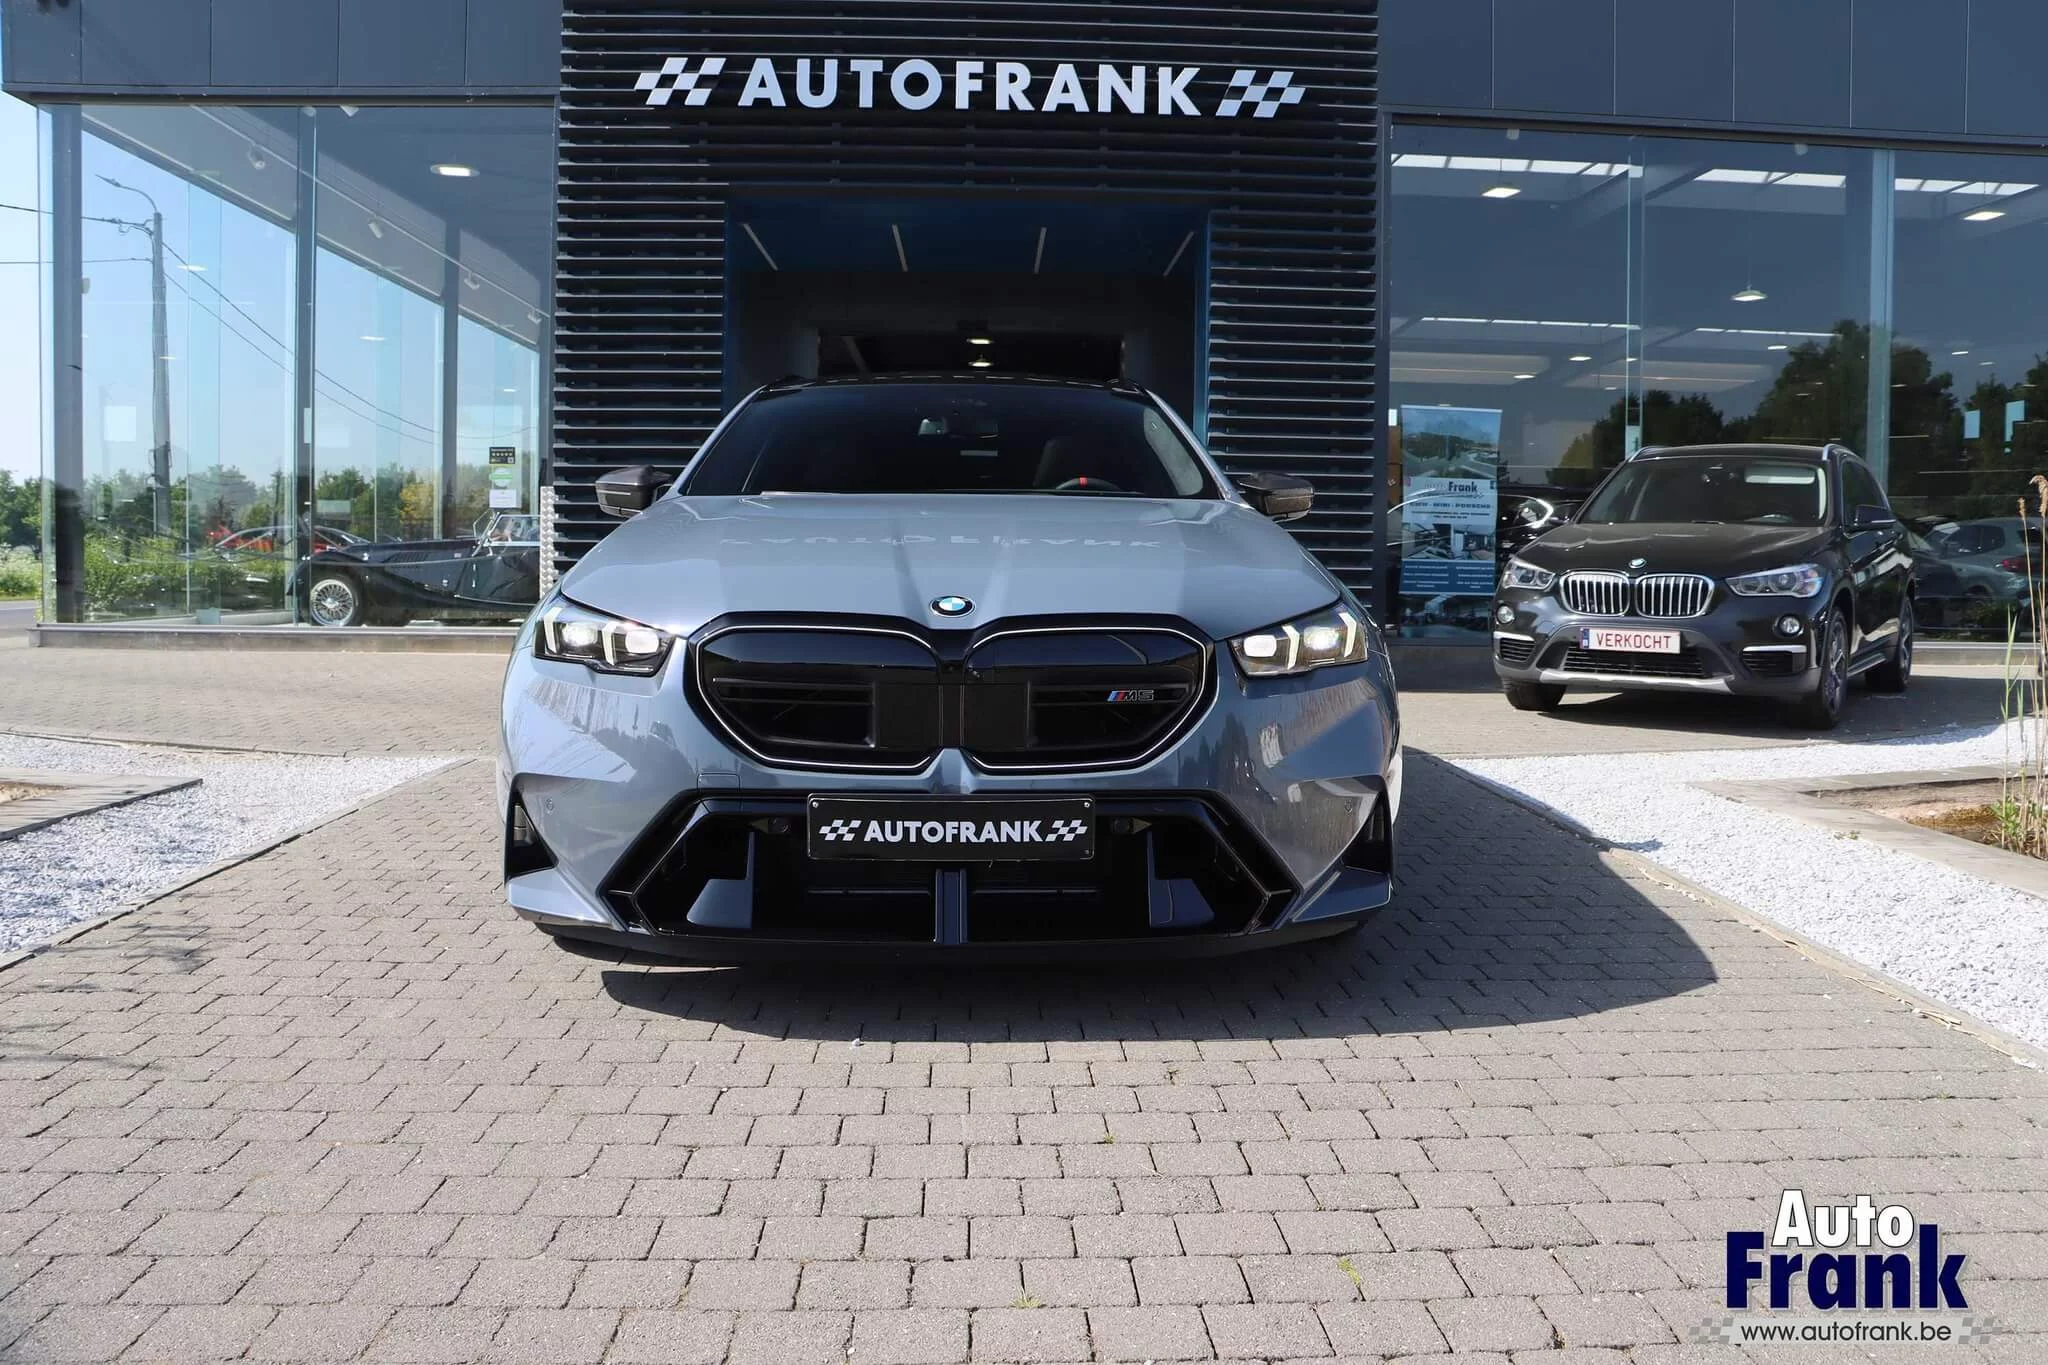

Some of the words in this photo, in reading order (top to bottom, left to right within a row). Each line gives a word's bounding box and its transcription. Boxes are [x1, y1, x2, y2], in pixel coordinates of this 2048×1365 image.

[737, 58, 1202, 118] AUTOFRANK
[1448, 481, 1478, 493] Frank
[1596, 632, 1672, 649] VERKOCHT
[1122, 689, 1154, 702] M5
[863, 819, 1044, 843] AUTOFRANK
